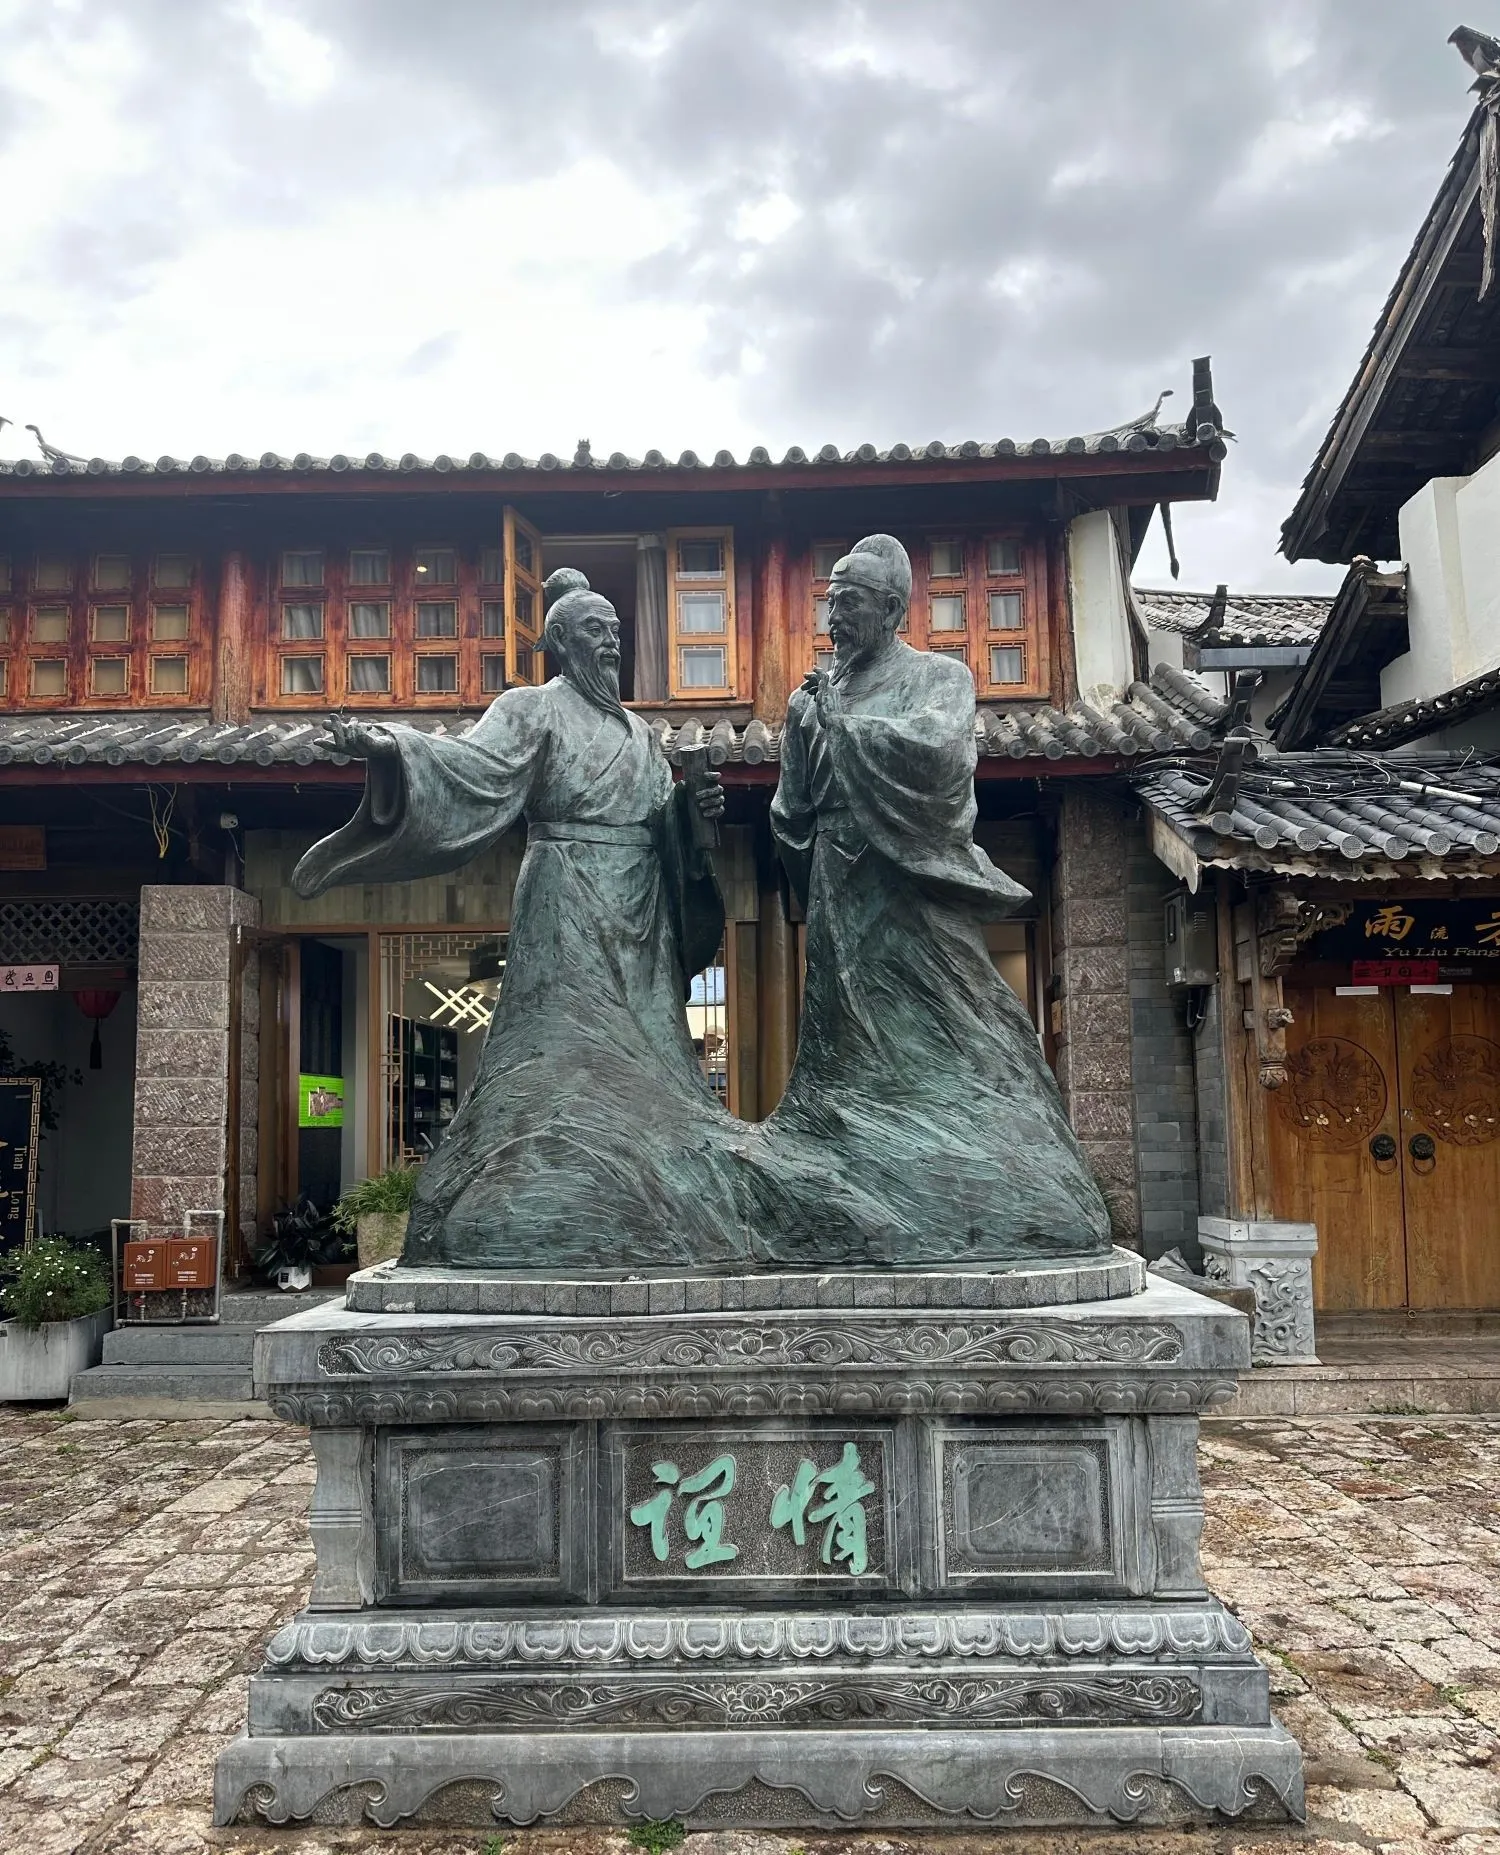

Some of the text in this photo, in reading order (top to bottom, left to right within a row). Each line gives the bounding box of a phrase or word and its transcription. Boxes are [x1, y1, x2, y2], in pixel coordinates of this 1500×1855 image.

[1383, 947, 1500, 958] Yu Liu Fang
[7, 1145, 28, 1220] Tian Long
